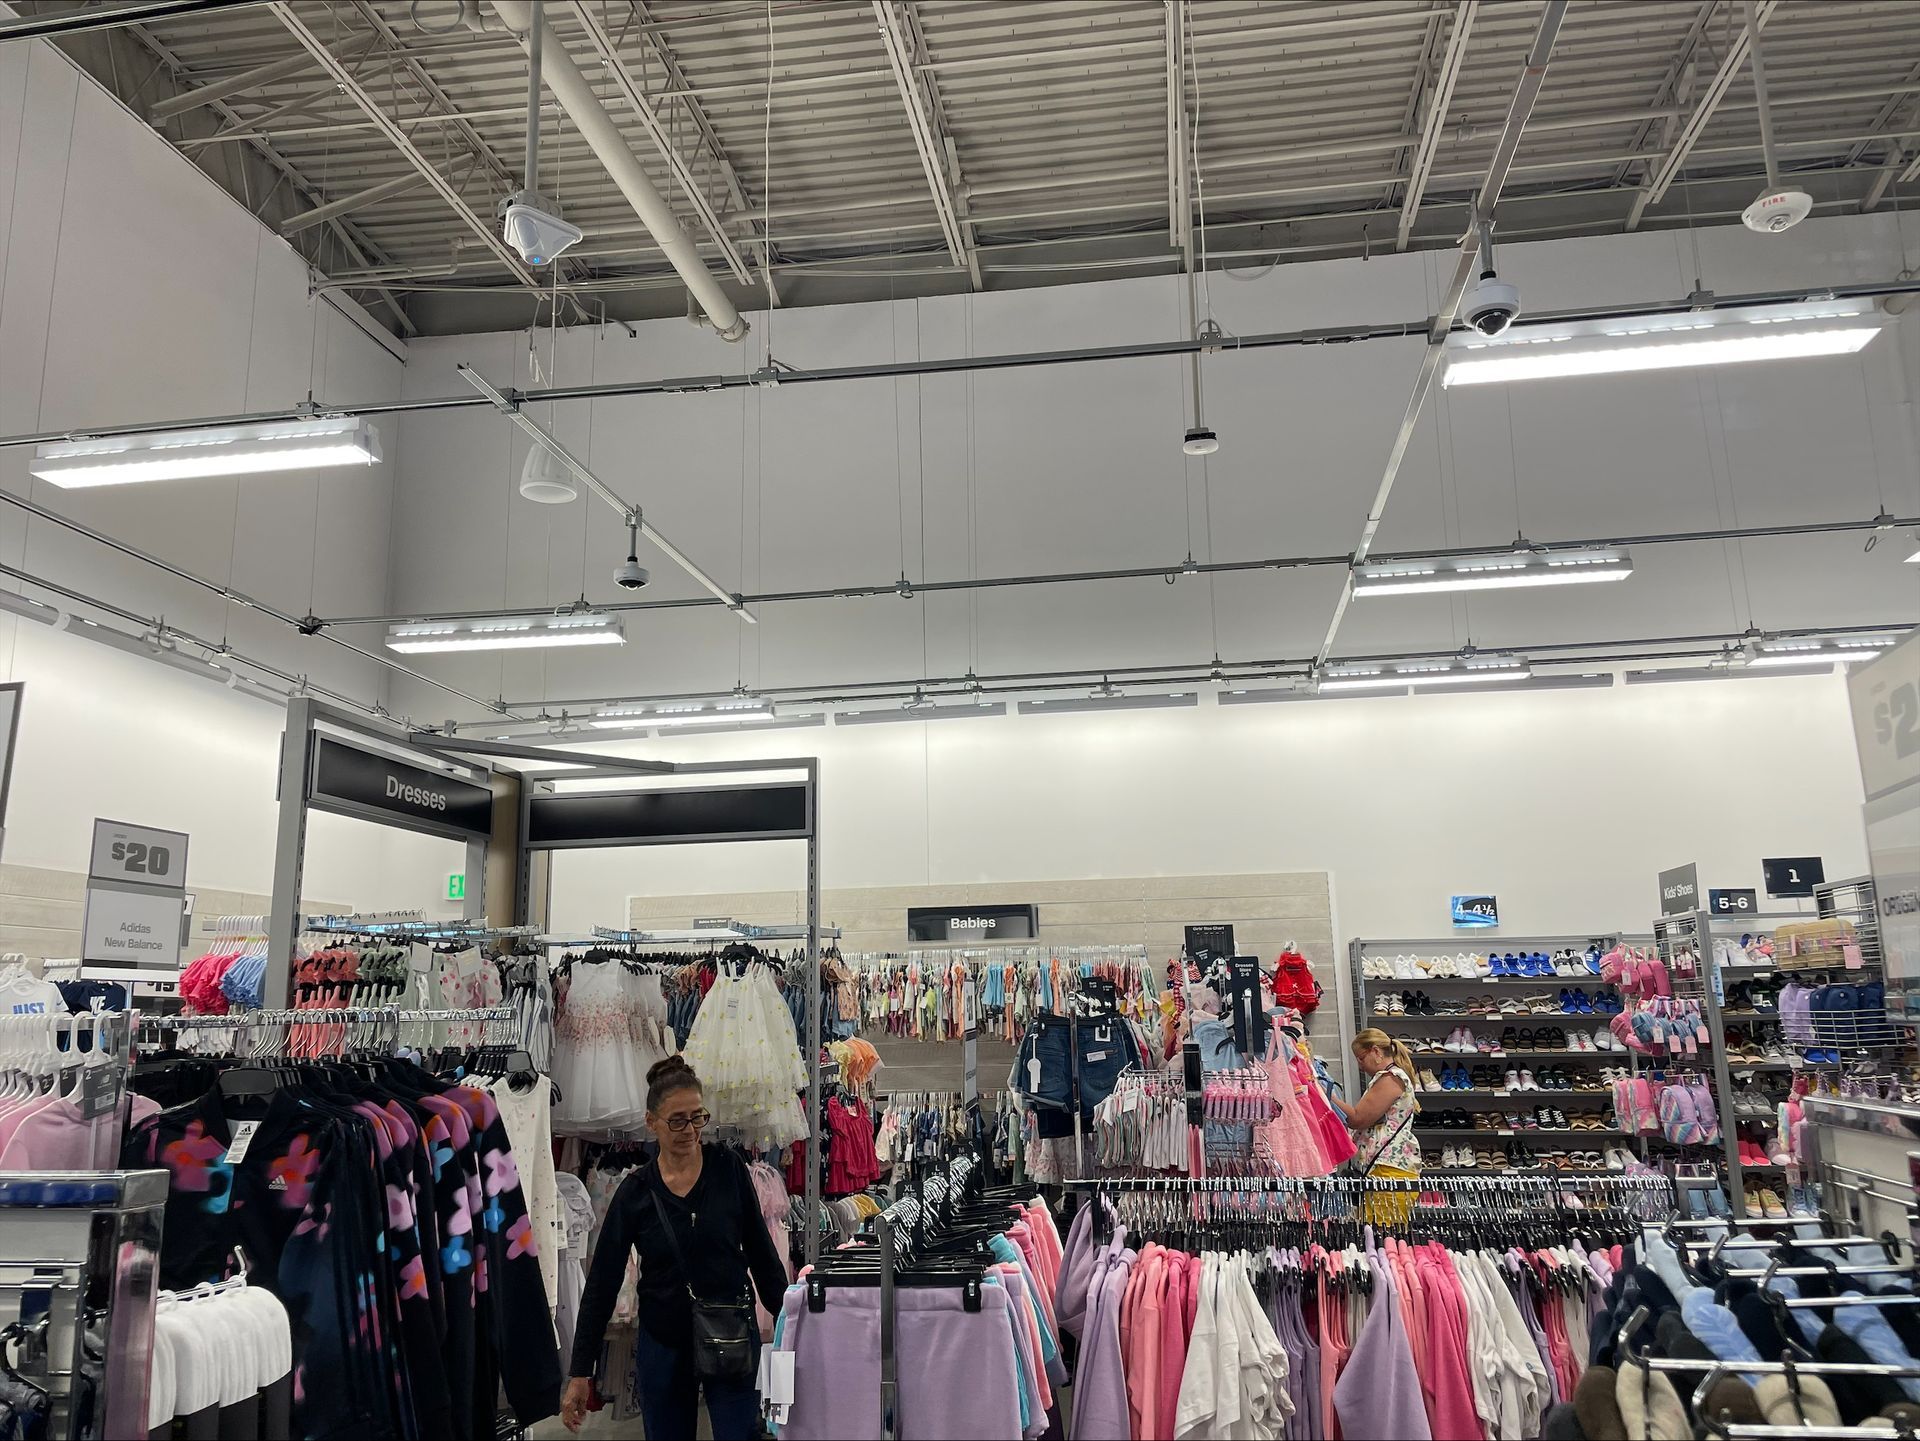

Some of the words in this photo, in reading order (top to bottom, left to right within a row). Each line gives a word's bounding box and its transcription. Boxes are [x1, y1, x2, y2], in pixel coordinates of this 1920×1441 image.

[1762, 196, 1786, 208] FIRE
[1873, 681, 1920, 761] $2
[386, 775, 446, 811] Dresses
[111, 842, 170, 876] $20
[1788, 868, 1801, 883] 1
[1677, 883, 1693, 898] Shoes
[119, 922, 151, 933] Adidas
[950, 917, 996, 929] Babies
[104, 936, 126, 948] New
[128, 938, 163, 950] Balance
[904, 1184, 915, 1192] XL
